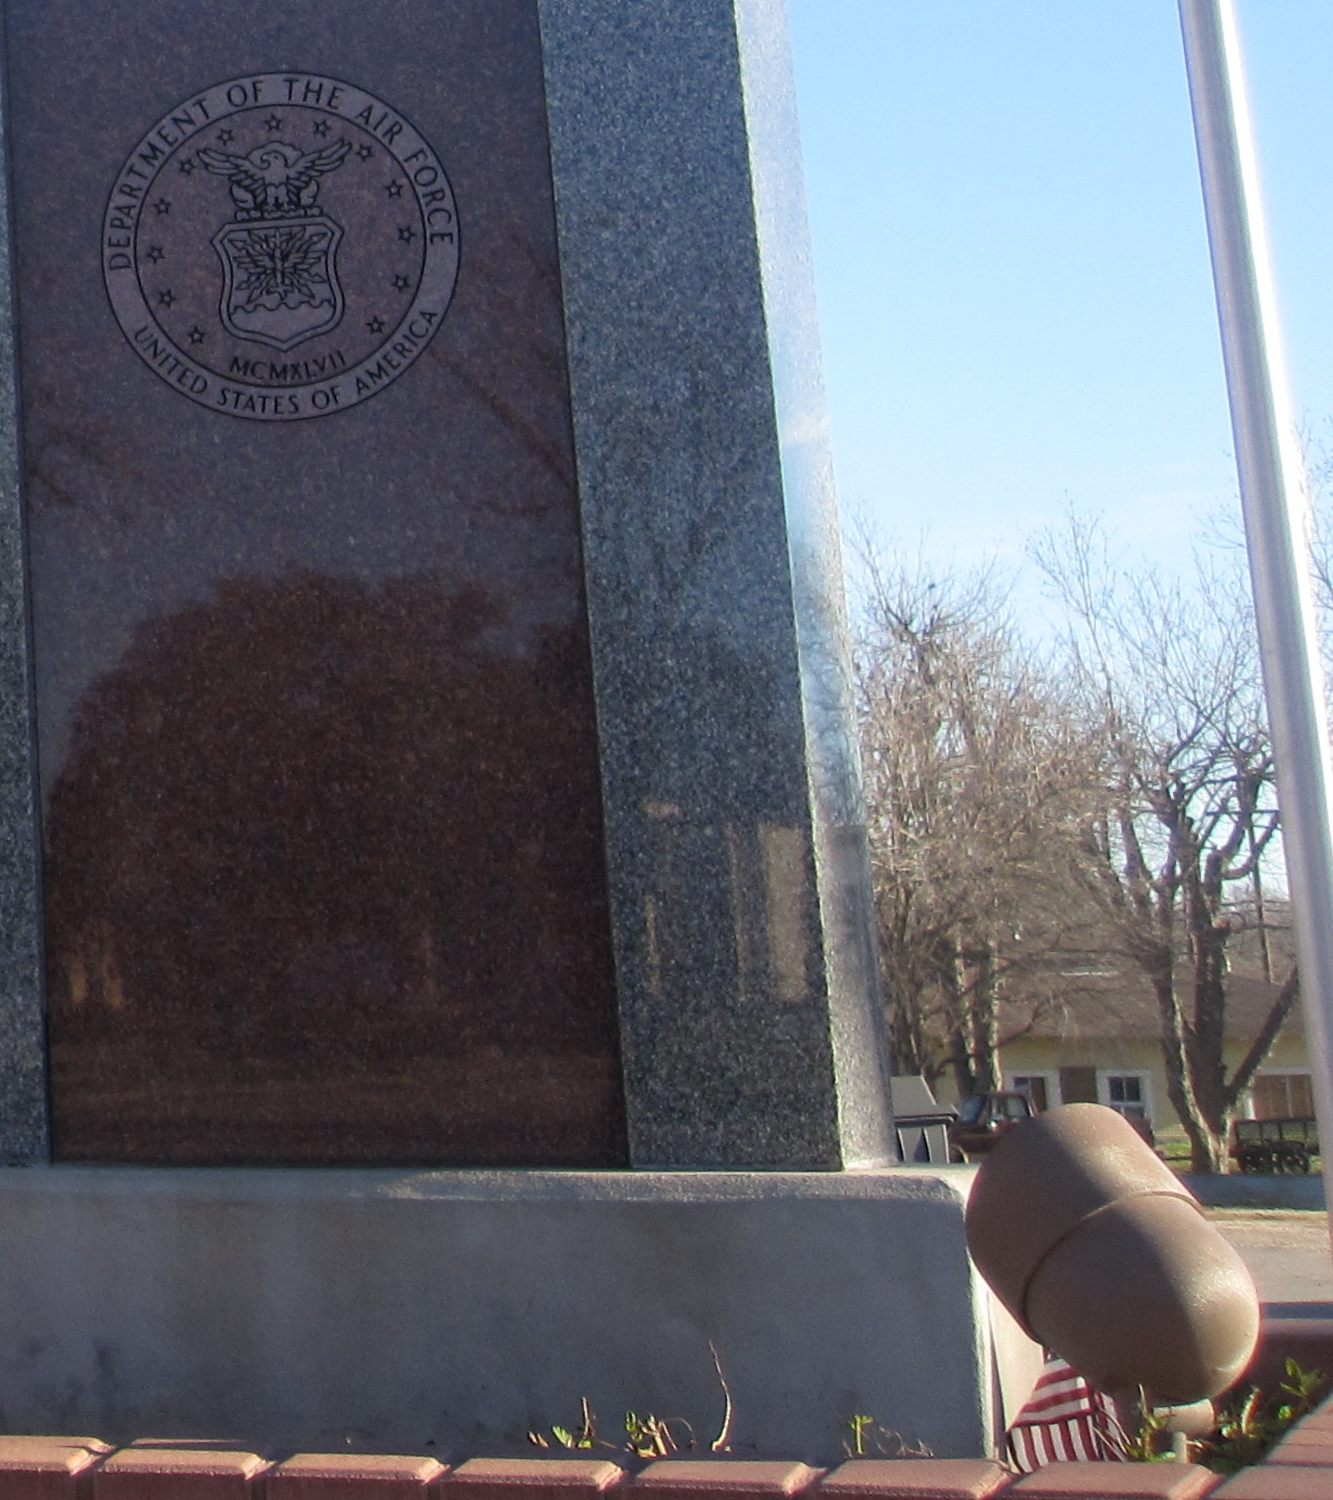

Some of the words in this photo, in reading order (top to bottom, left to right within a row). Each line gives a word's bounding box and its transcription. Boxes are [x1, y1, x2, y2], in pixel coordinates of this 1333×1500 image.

[107, 97, 212, 273] DEPARTMENT
[225, 79, 266, 109] OF
[282, 76, 345, 109] THE
[354, 102, 407, 146] AIR
[403, 146, 455, 246] FORCE
[132, 324, 209, 396] UNITED
[216, 386, 300, 416] STATES
[310, 384, 343, 411] OF
[354, 308, 439, 398] AMERICA
[229, 348, 348, 382] MCMXLVII
